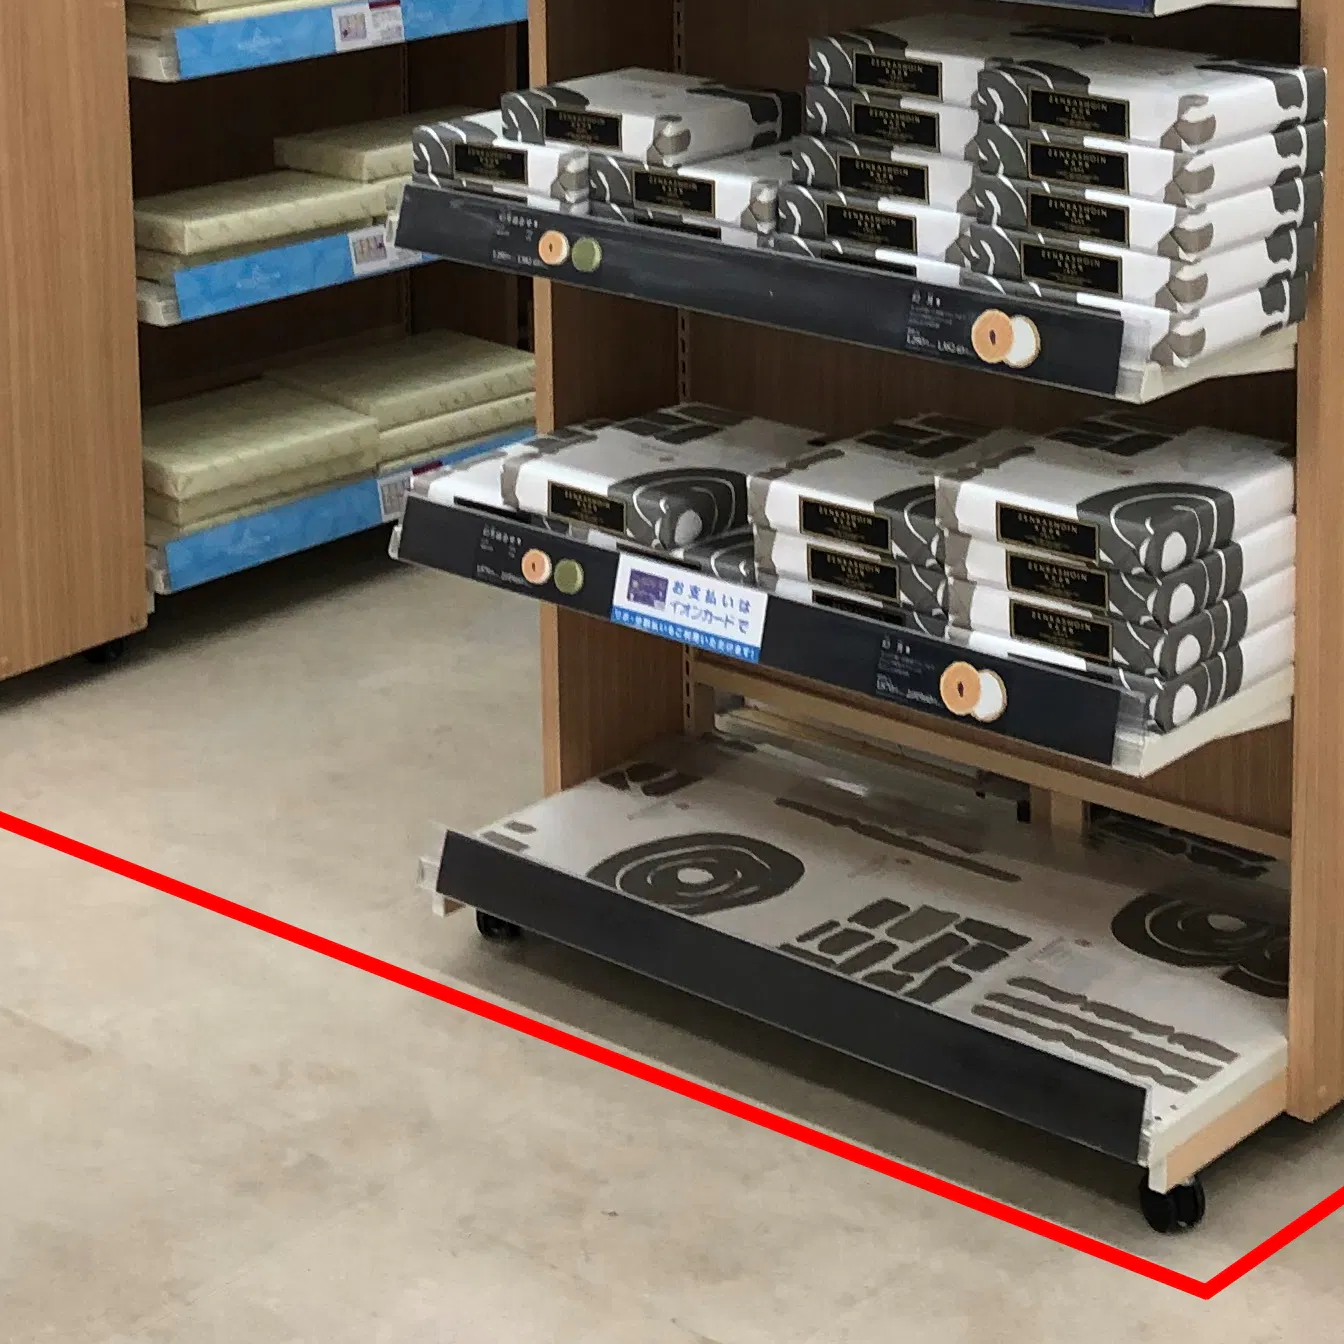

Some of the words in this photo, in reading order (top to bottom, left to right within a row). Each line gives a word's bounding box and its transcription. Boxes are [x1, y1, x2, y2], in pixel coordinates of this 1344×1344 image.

[672, 580, 752, 614] お支払いは
[670, 600, 750, 635] イオンカードで
